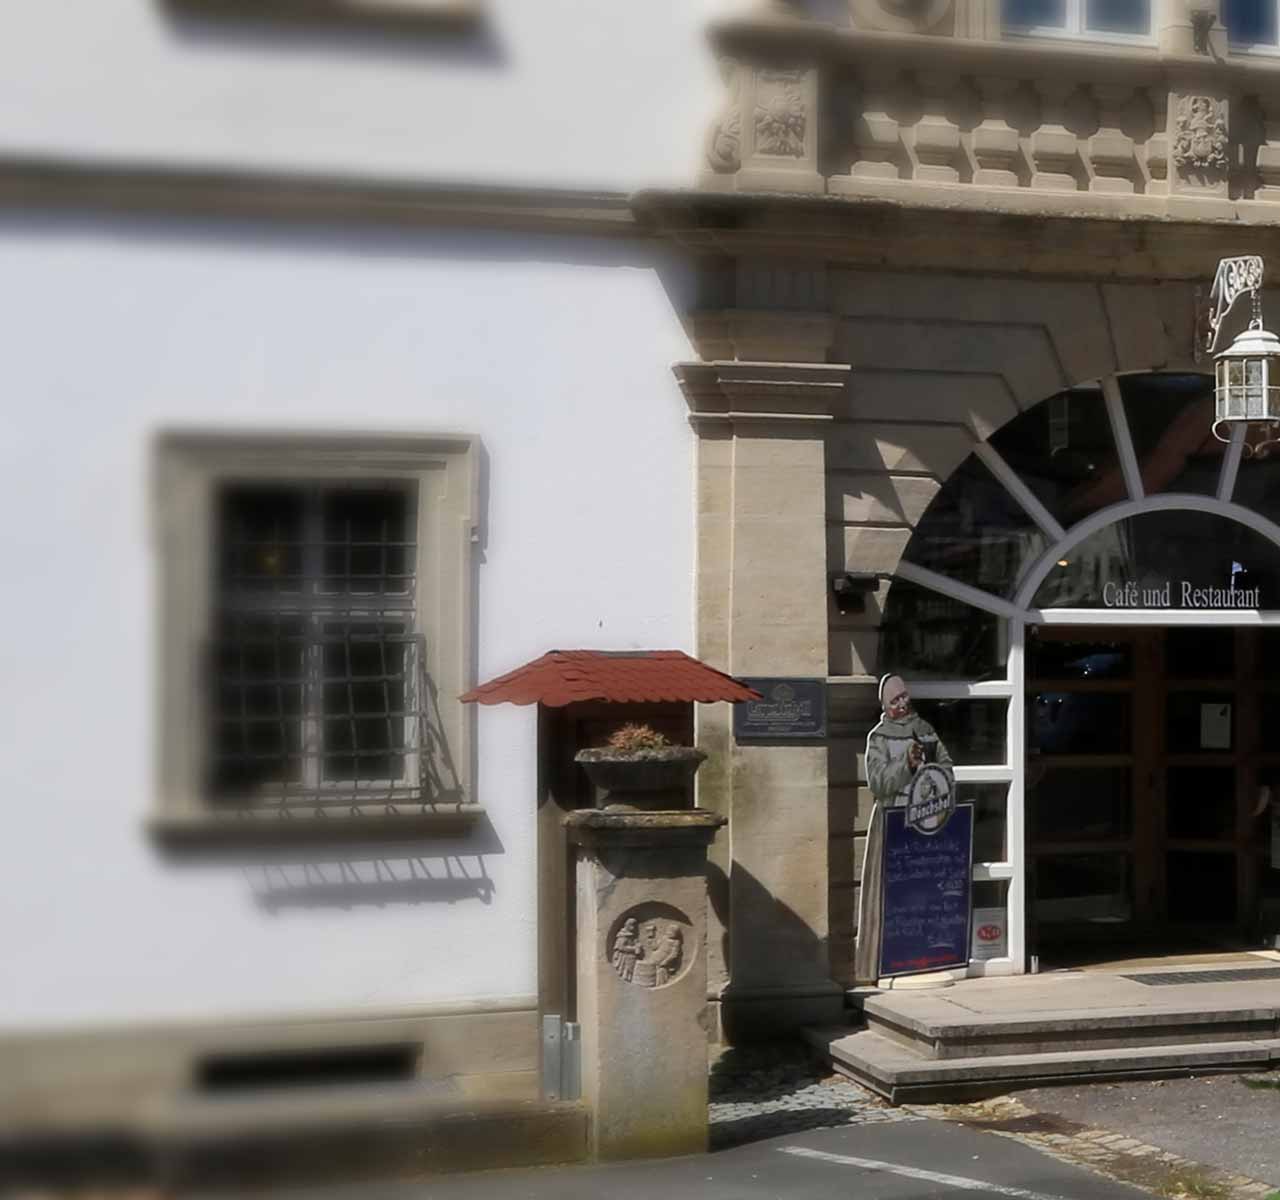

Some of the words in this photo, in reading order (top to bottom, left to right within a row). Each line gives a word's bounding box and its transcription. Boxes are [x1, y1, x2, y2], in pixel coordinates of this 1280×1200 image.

[1103, 581, 1138, 607] Café
[1143, 581, 1171, 607] und
[1181, 581, 1260, 608] Restaurant
